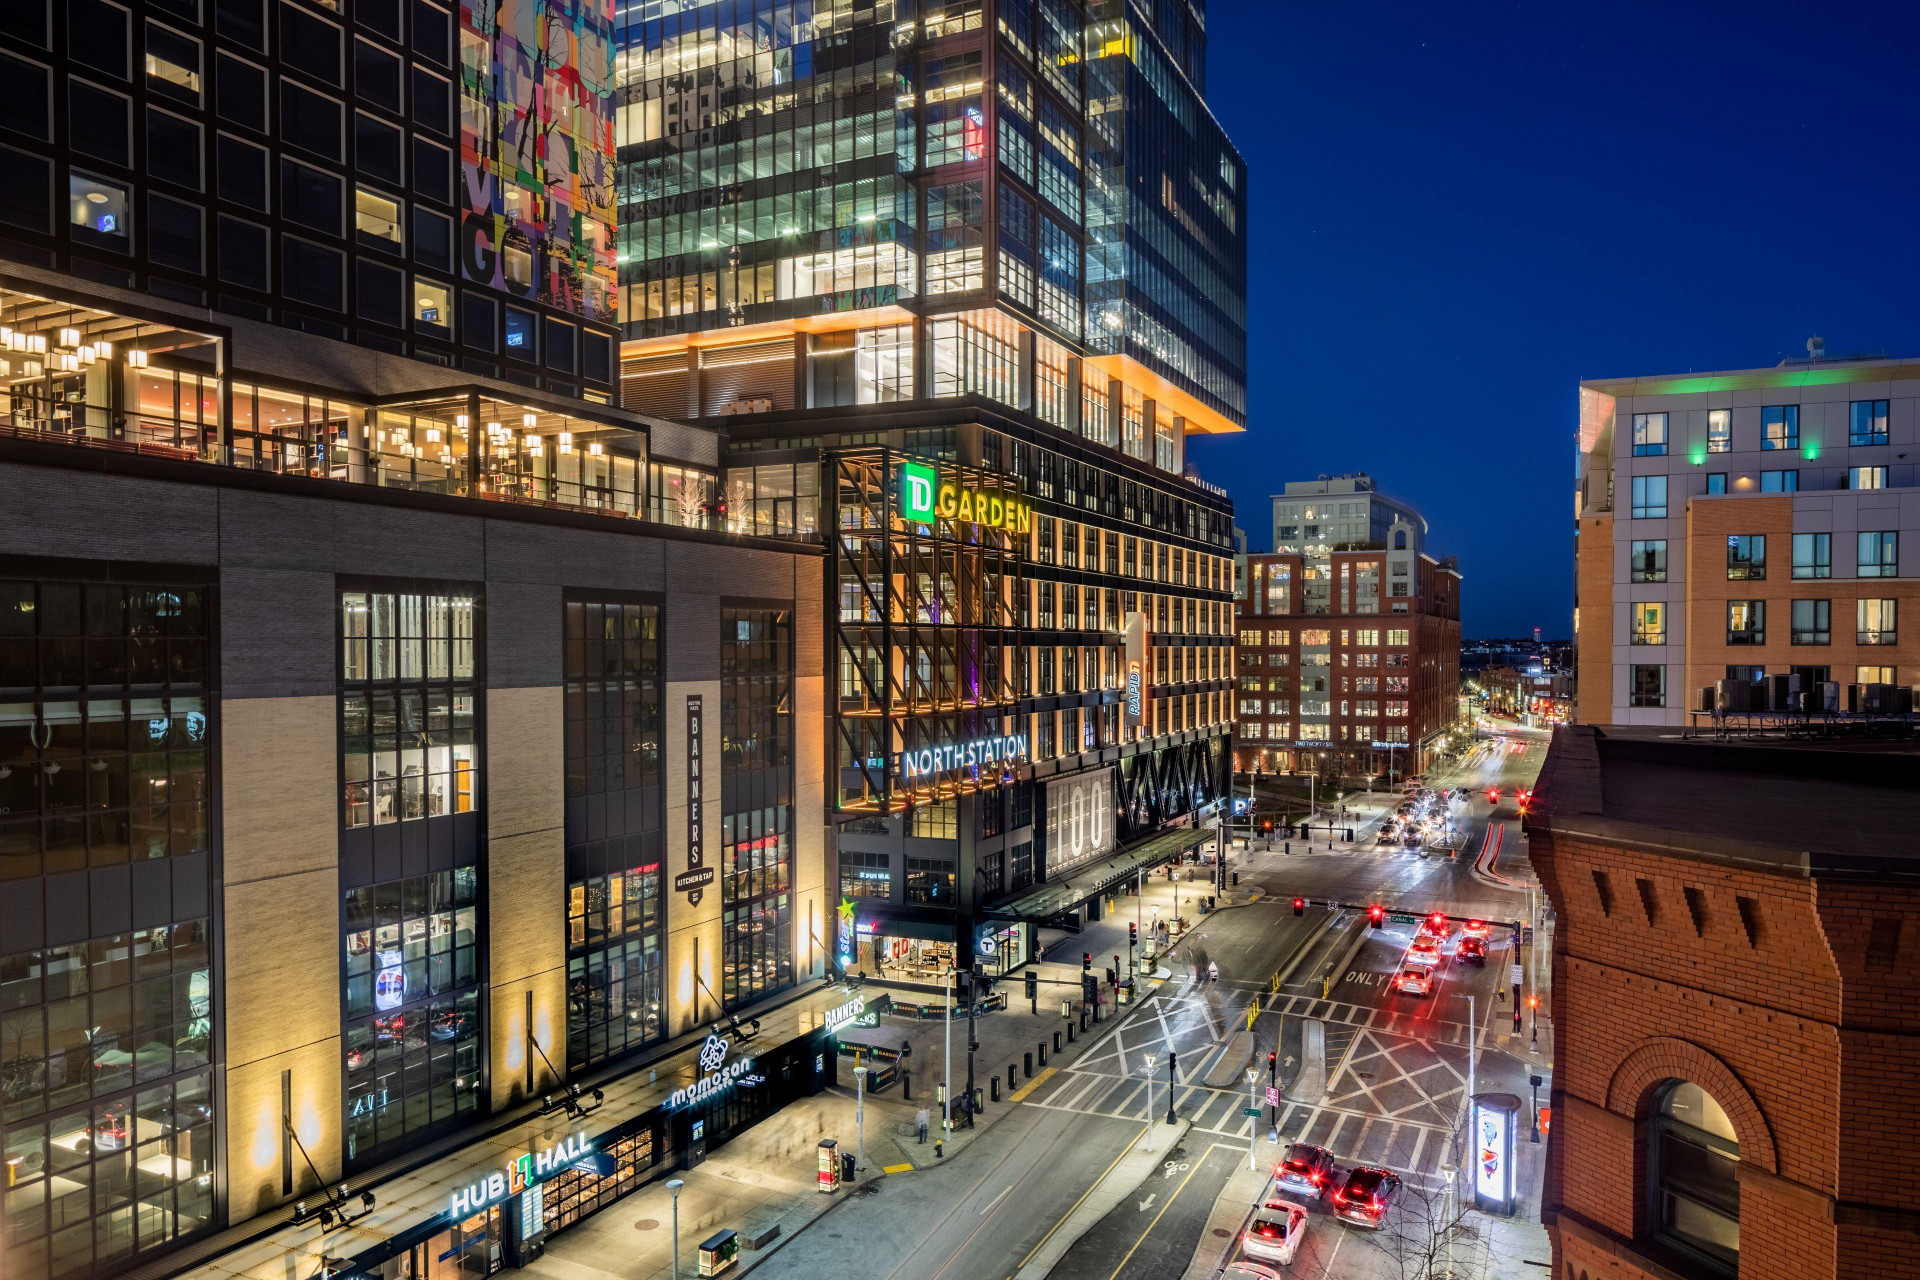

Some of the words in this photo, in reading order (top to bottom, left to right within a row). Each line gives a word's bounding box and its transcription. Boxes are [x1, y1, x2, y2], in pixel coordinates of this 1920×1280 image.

[907, 475, 932, 512] TD
[939, 484, 1031, 534] GARDEN
[906, 743, 965, 778] NORTH
[968, 734, 1027, 766] STATION
[691, 717, 699, 864] BANNERS
[1235, 800, 1246, 815] P
[1057, 780, 1103, 864] 100
[677, 874, 699, 887] KITCHEN
[703, 872, 712, 880] TAP
[982, 941, 993, 951] T
[1345, 971, 1386, 987] ONLY
[824, 994, 865, 1032] BANNERS
[671, 1058, 750, 1107] momosan
[452, 1172, 505, 1218] HUB
[536, 1131, 592, 1175] HALL
